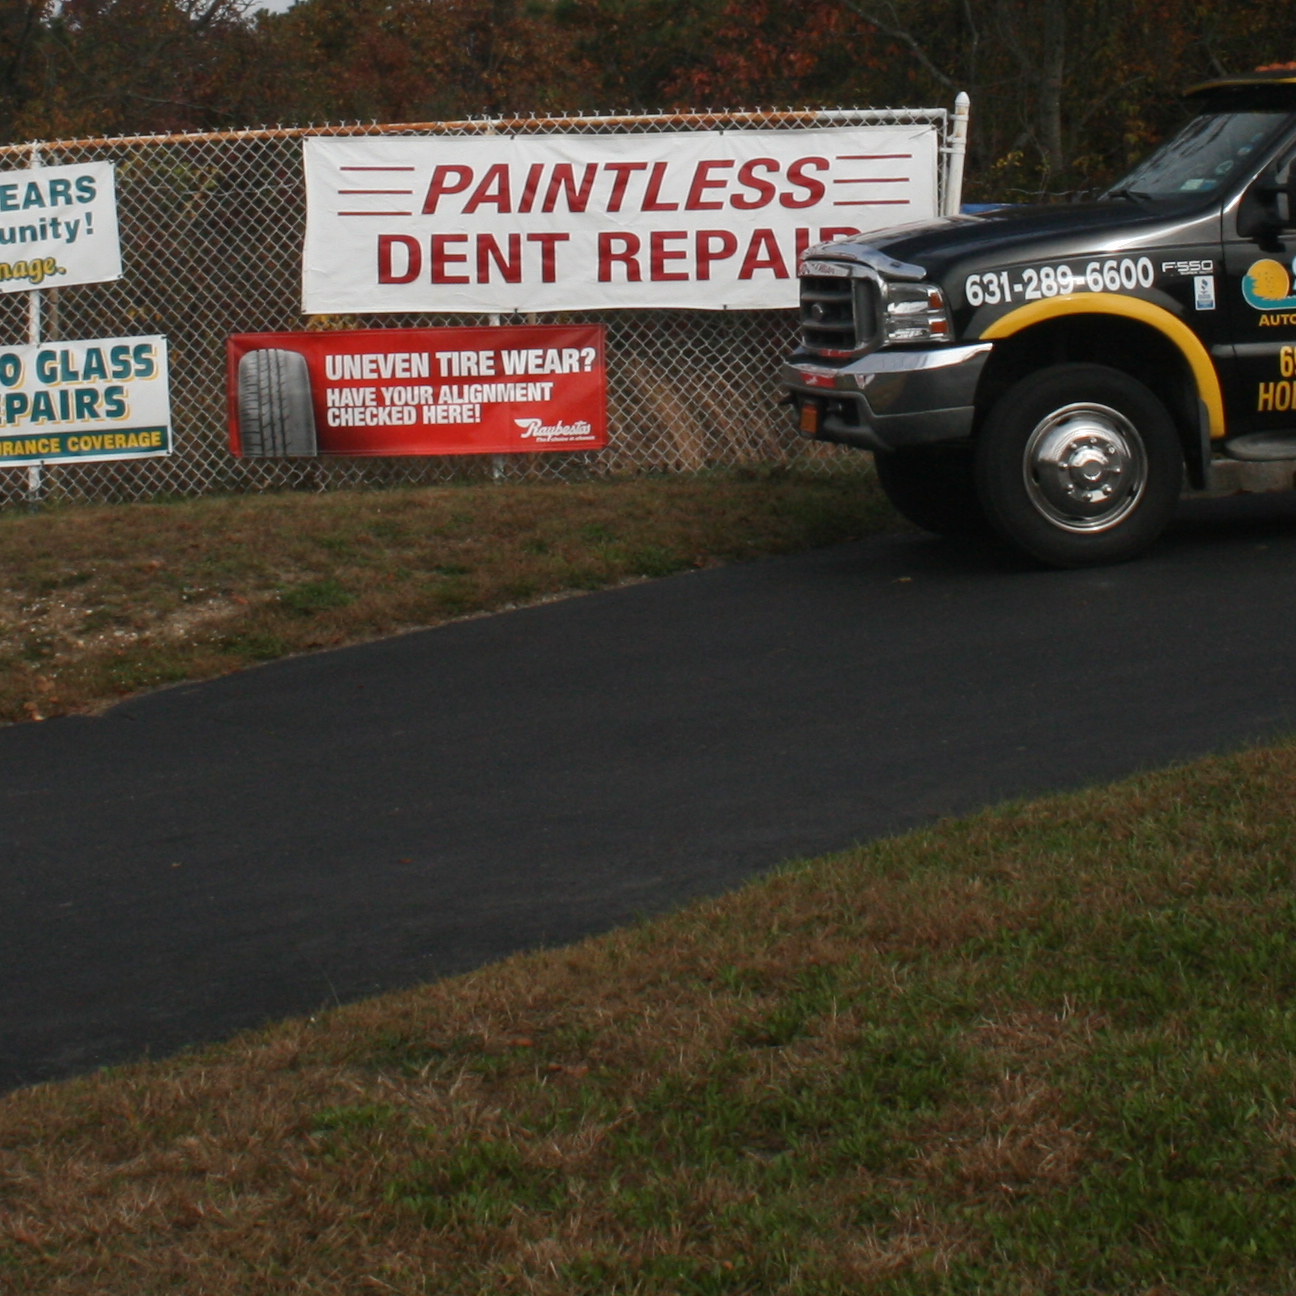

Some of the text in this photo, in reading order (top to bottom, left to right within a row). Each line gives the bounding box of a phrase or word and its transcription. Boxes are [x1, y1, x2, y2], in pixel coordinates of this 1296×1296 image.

[421, 156, 830, 215] PAINTLESS
[377, 232, 570, 285] DENT
[965, 256, 1154, 306] 631-289-6600
[36, 344, 157, 386] GLASS
[325, 348, 596, 380] UNEVEN TIRE WEAR?
[326, 382, 553, 407] HAVE YOUR ALIGNMENT
[327, 404, 481, 427] CHECKED HERE!
[67, 432, 161, 451] COVERAGE
